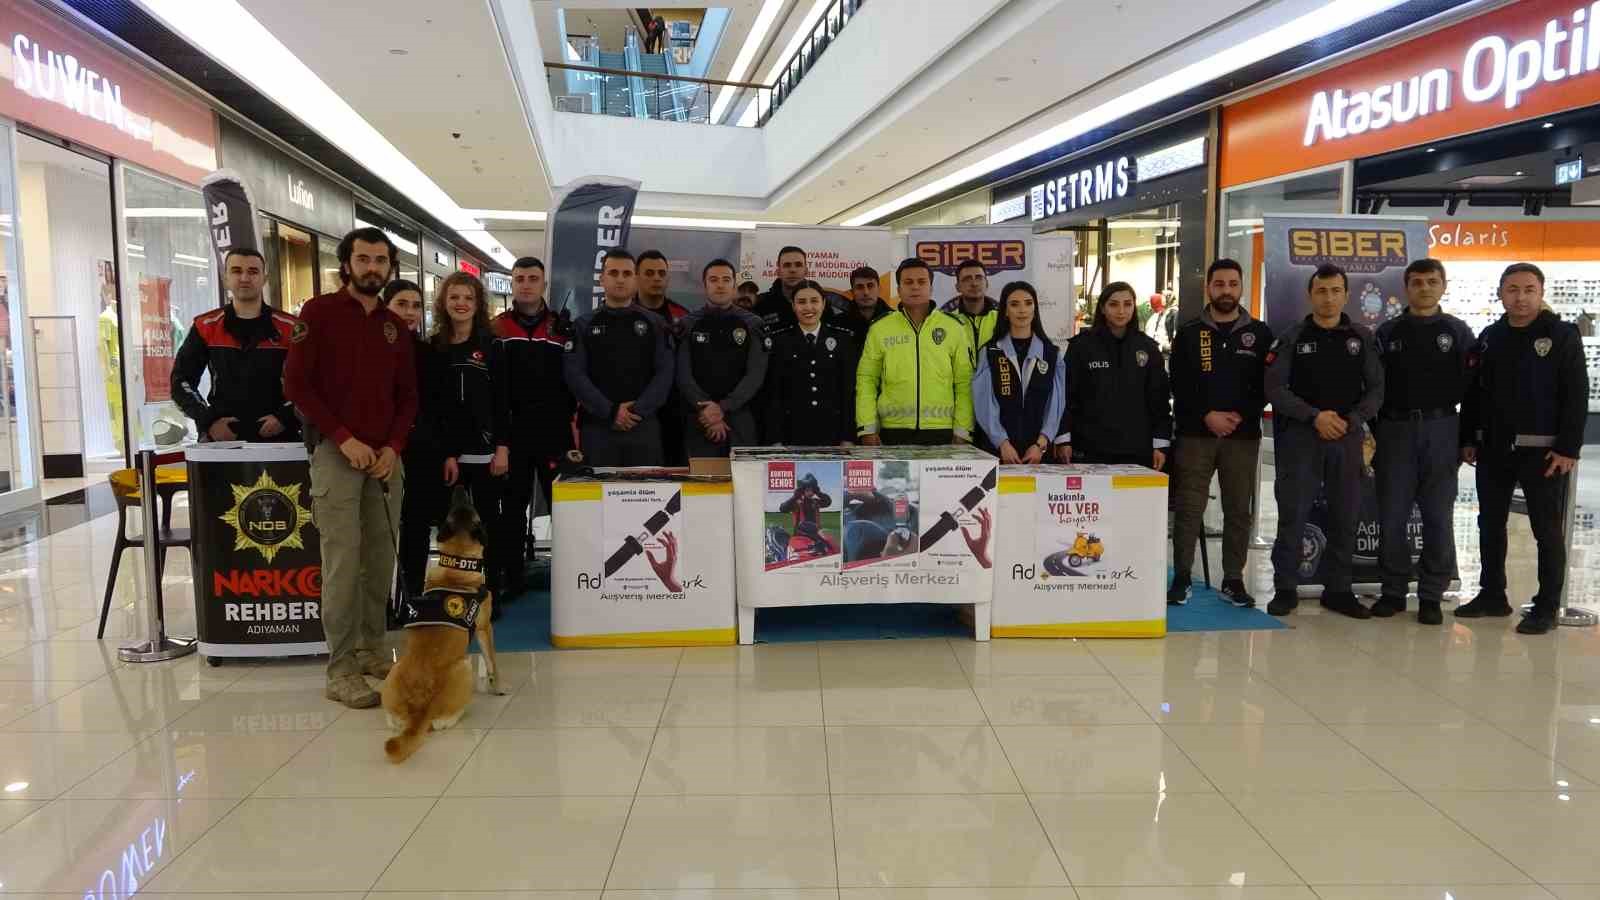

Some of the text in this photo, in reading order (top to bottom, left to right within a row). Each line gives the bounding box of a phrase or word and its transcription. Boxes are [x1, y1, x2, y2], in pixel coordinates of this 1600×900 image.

[13, 33, 122, 131] SUWEN
[1304, 68, 1449, 147] Atasun
[1046, 156, 1130, 216] SETRMS
[1428, 224, 1508, 249] Solaris
[770, 478, 793, 488] SENDE
[848, 477, 872, 487] SENDE
[1048, 502, 1099, 514] YOL VER
[820, 573, 960, 589] Alışveriş Merkezi
[225, 602, 320, 621] REHBER
[247, 624, 300, 634] ADIYAMAN
